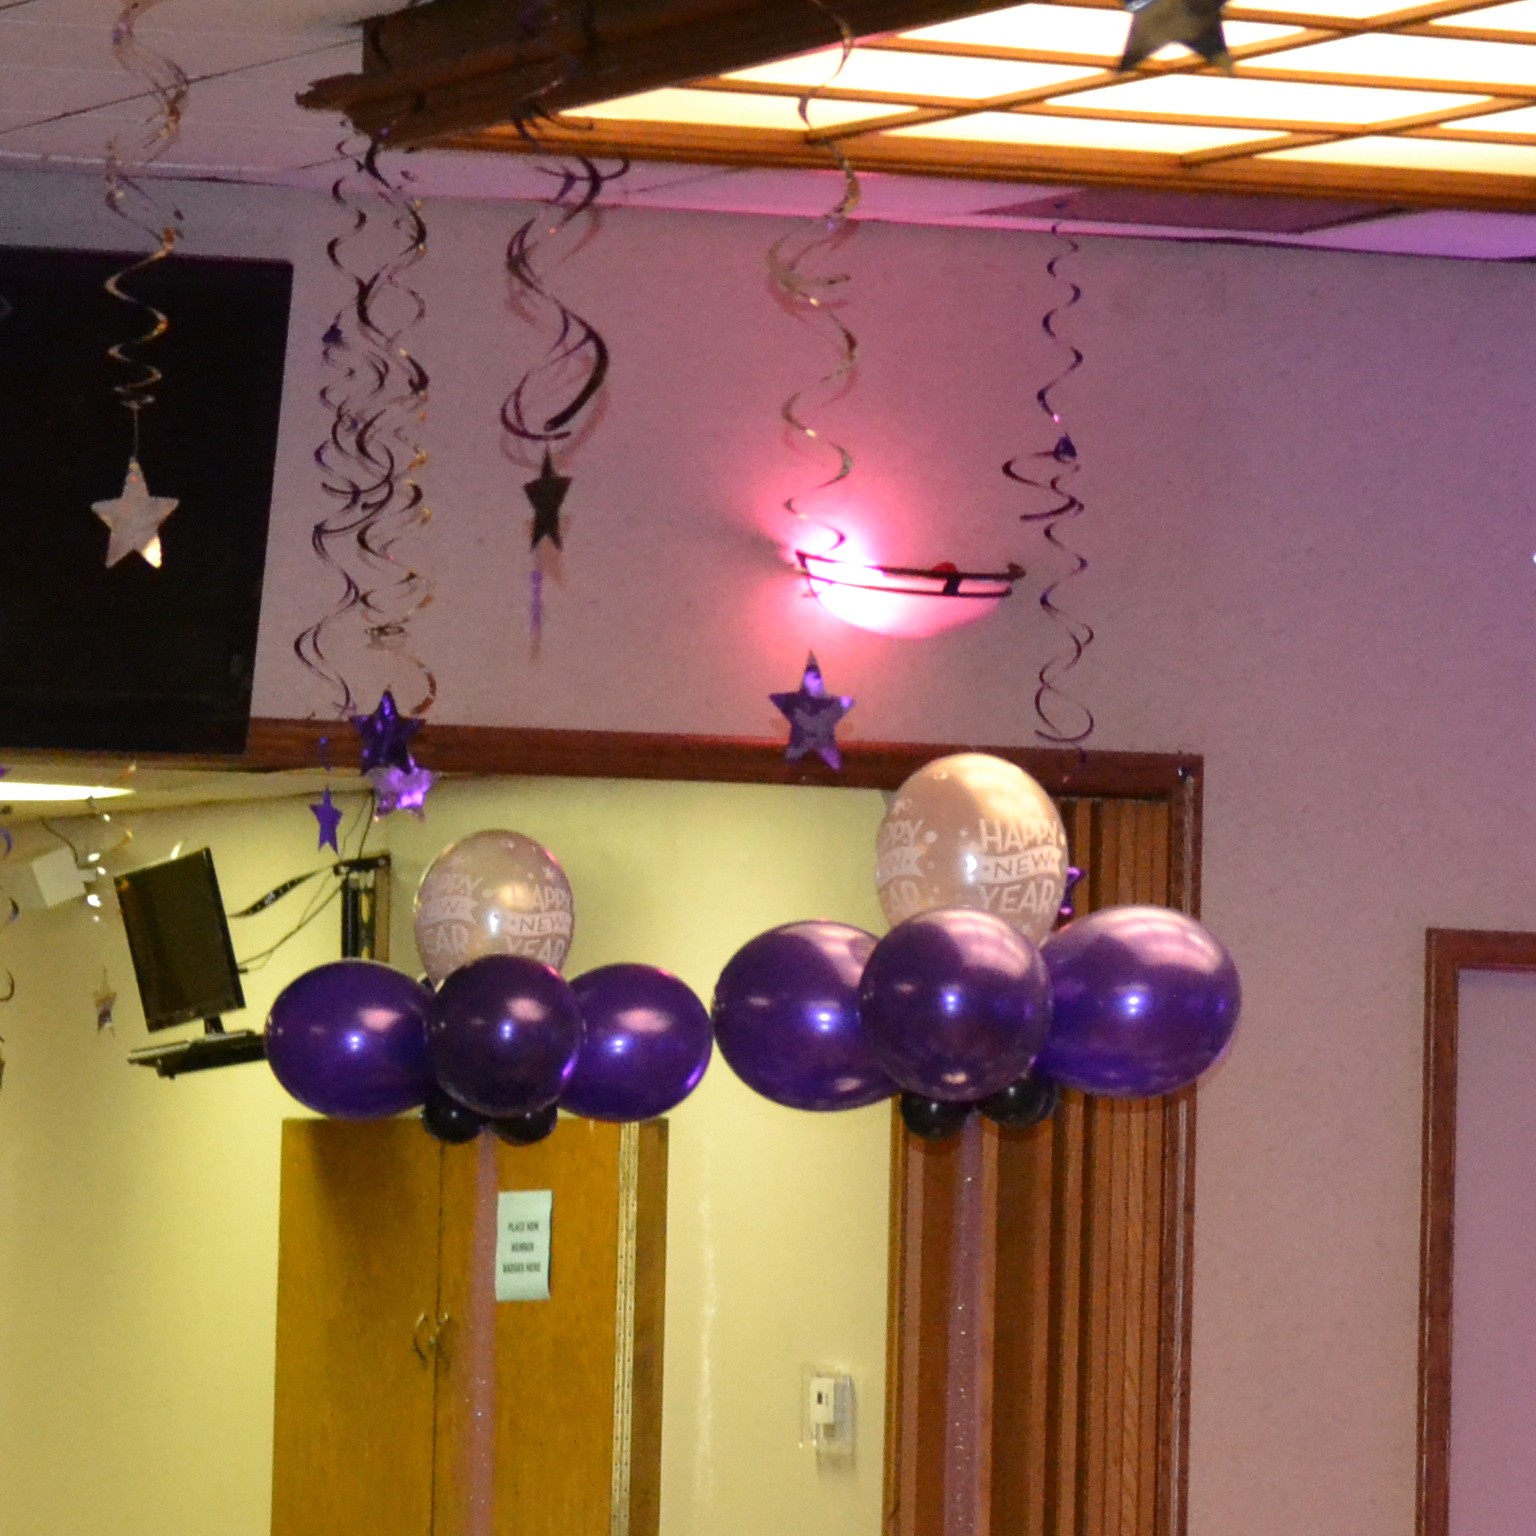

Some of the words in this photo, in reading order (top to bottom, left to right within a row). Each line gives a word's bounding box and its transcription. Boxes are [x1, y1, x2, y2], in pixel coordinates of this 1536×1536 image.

[978, 818, 1059, 852] HAPPY
[993, 853, 1050, 879] NEW
[977, 880, 1056, 914] YEAR
